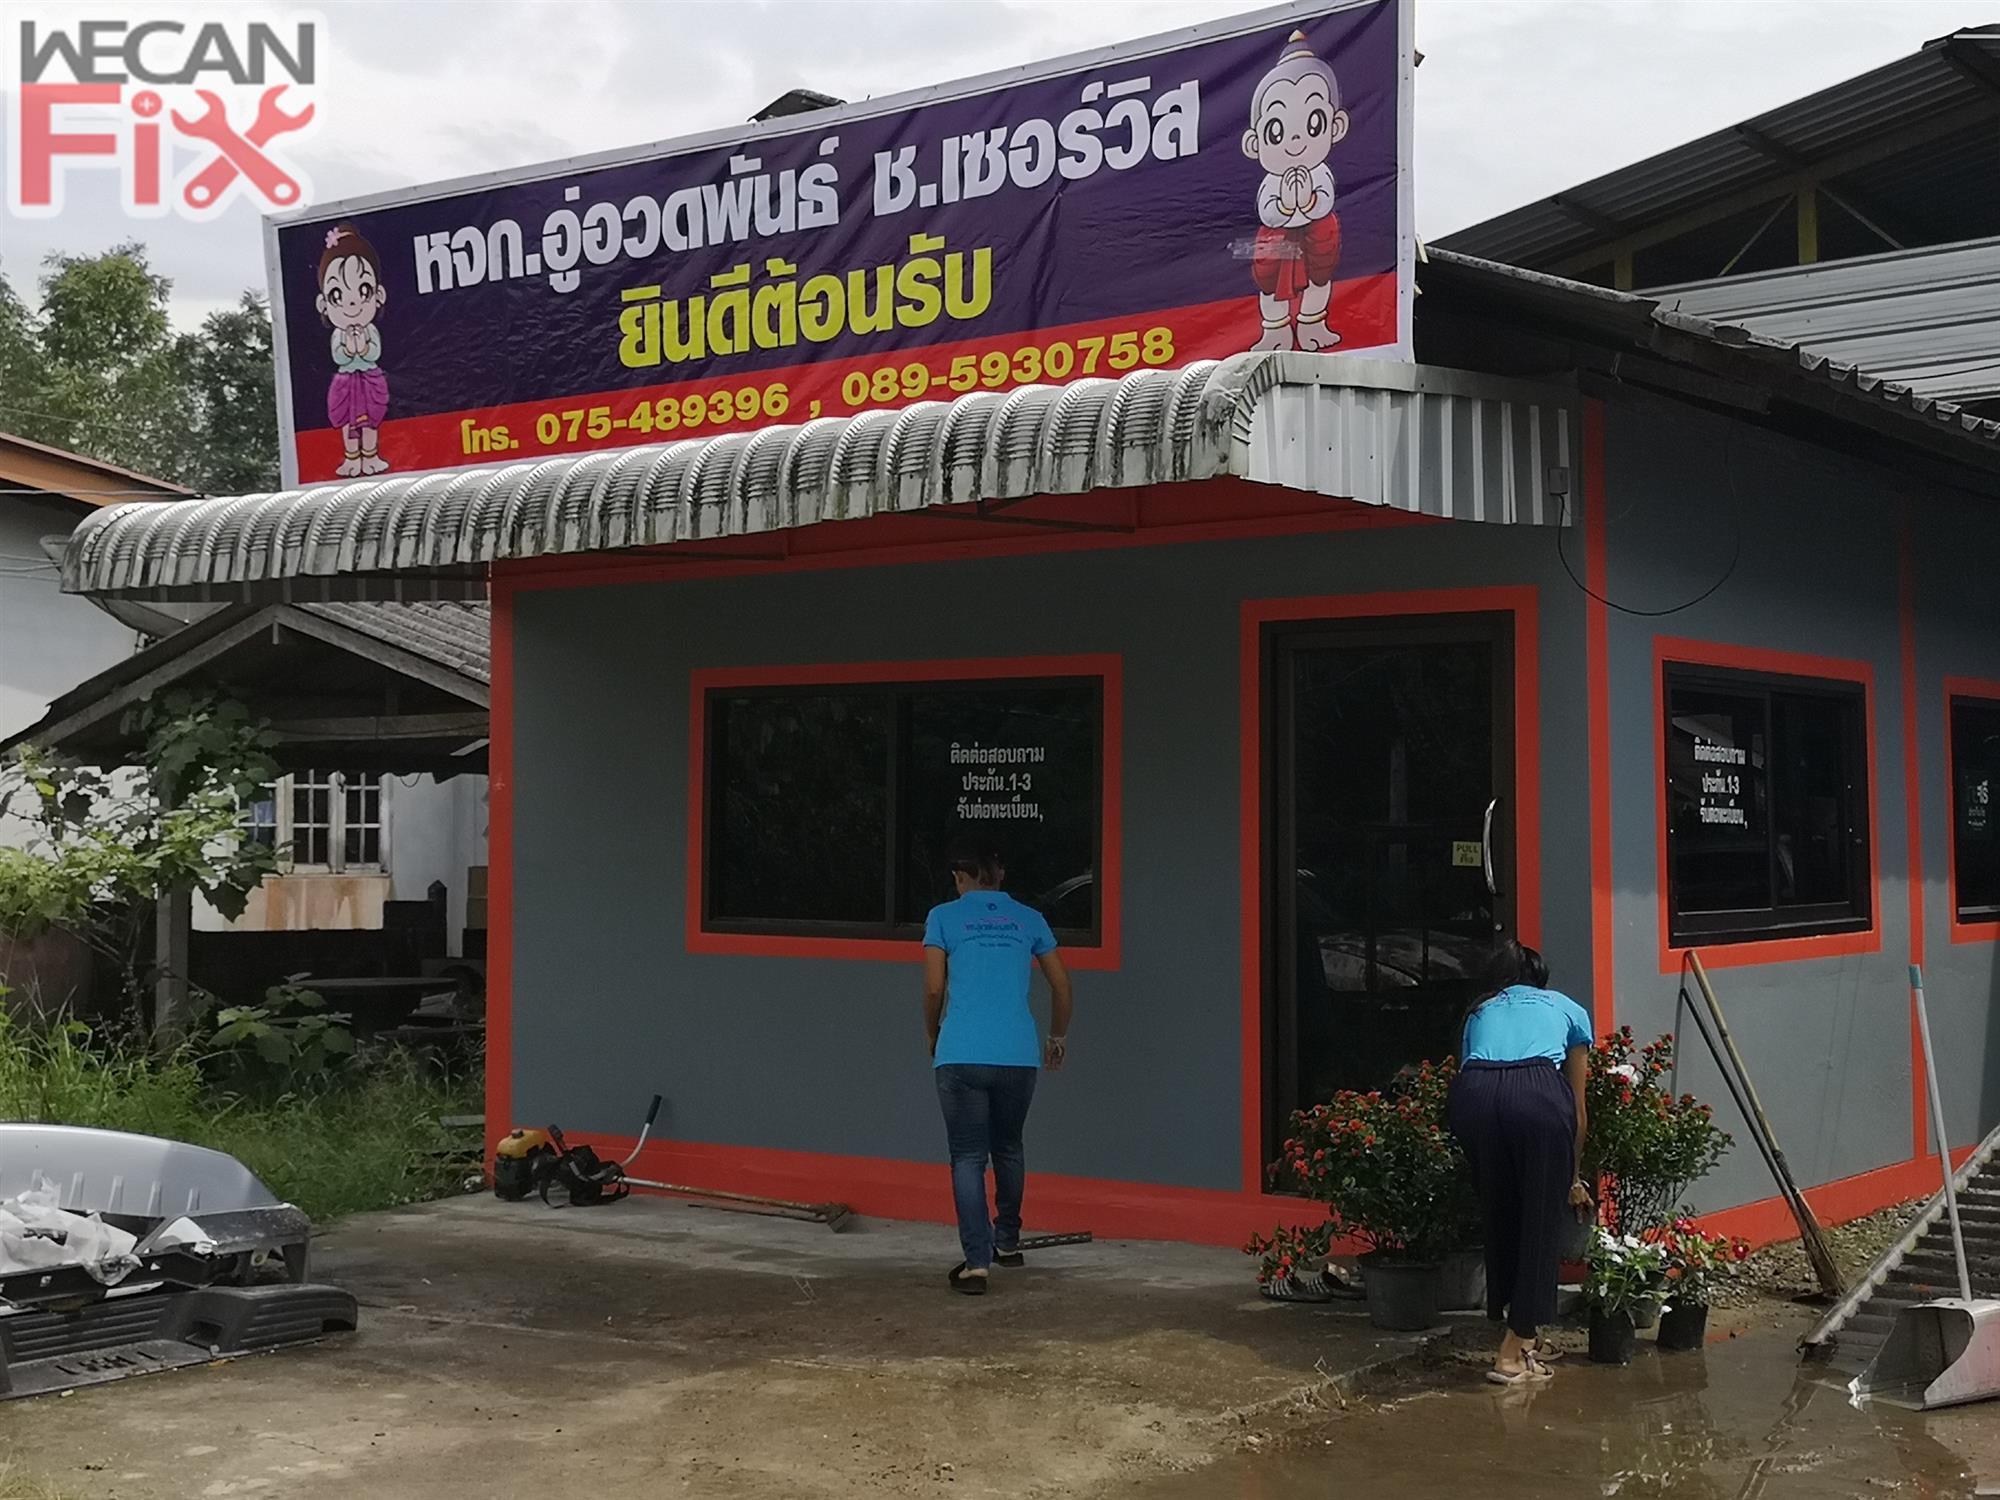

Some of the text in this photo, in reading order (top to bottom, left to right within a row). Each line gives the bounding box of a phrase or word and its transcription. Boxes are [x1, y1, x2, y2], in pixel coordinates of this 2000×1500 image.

[618, 233, 993, 369] ยินดีต้อนรับ
[460, 419, 520, 455] โทร.
[535, 382, 790, 446] 075-489396
[841, 326, 1176, 407] 089-5930758
[950, 741, 1045, 764] ติดต่อสอบถาม
[1456, 843, 1479, 853] PULL
